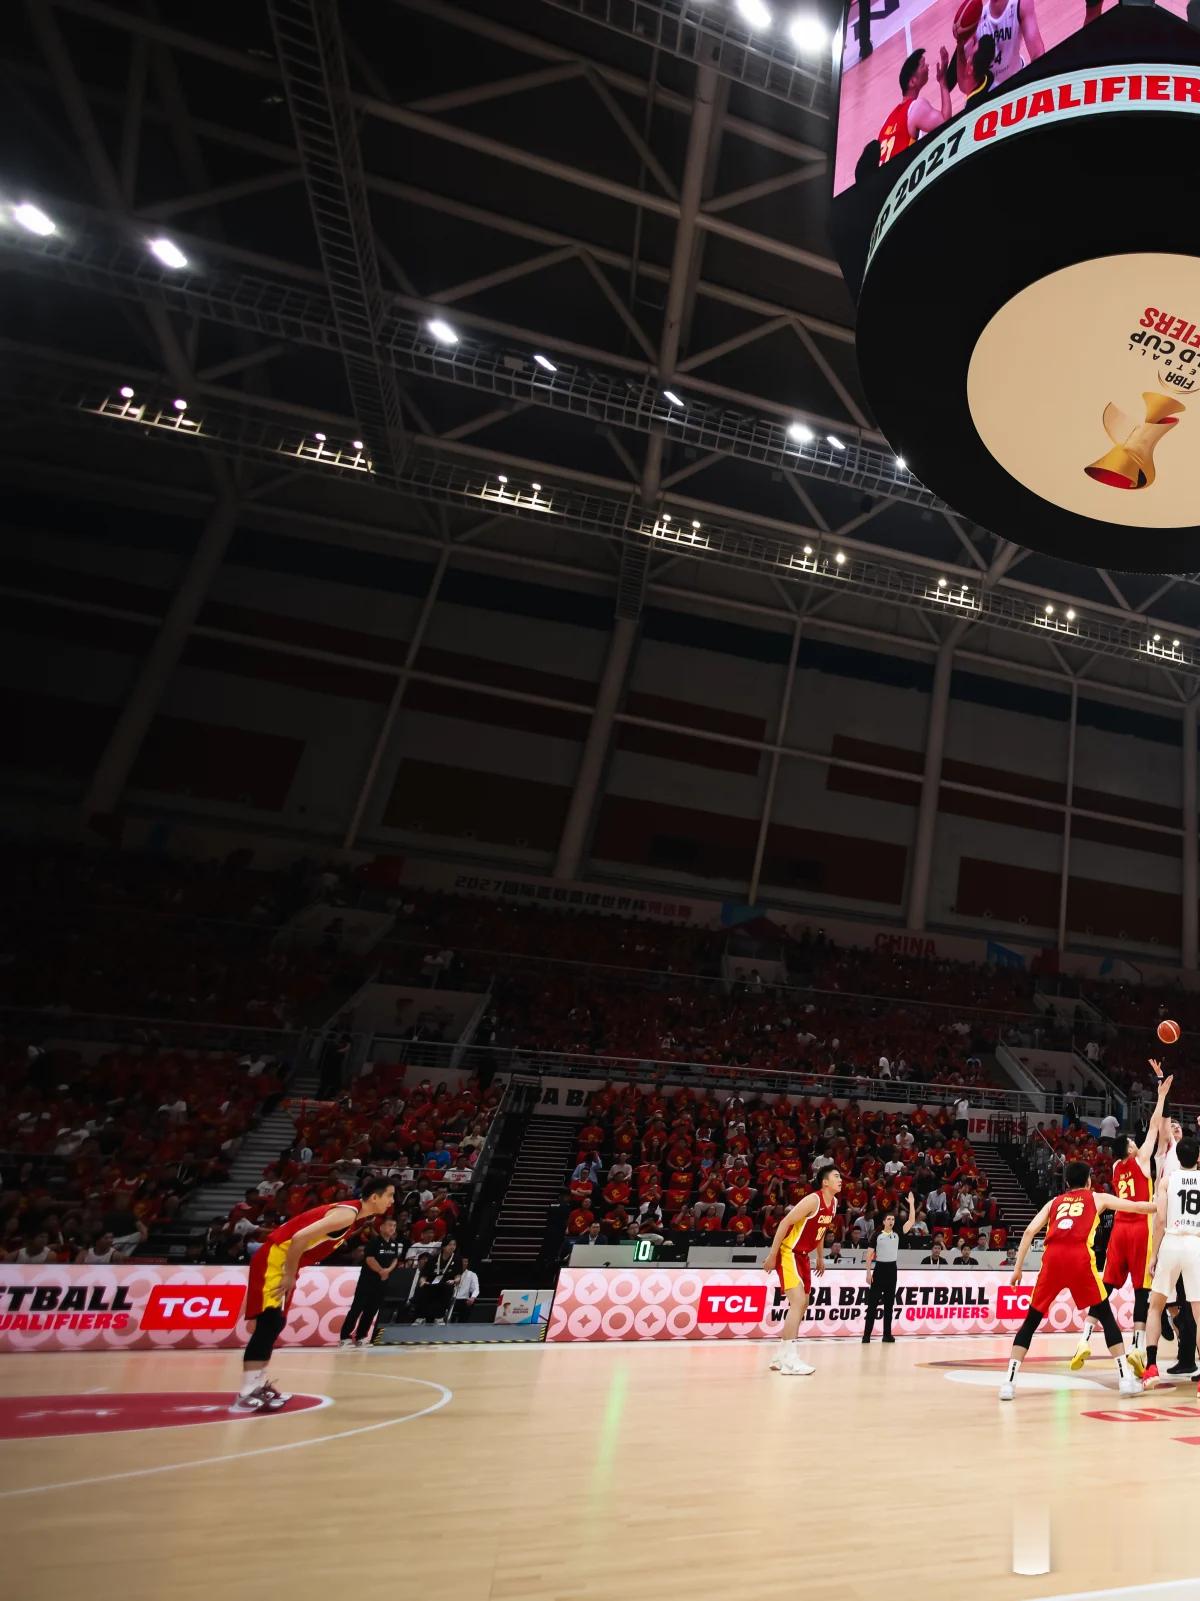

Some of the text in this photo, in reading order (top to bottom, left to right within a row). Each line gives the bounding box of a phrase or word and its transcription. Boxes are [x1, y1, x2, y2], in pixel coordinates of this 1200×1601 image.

[993, 26, 1012, 42] PAN
[894, 126, 966, 213] 2027
[1130, 330, 1176, 354] CUP
[1164, 370, 1195, 390] FIBA
[1118, 1178, 1135, 1199] 21
[1056, 1202, 1084, 1220] 26
[707, 1296, 758, 1313] TCL
[773, 1287, 989, 1306] FBA BAKETBALL
[1003, 1295, 1032, 1311] TC
[159, 1297, 230, 1318] TCL
[771, 1308, 826, 1321] WLD
[829, 1308, 861, 1320] CUP
[906, 1307, 989, 1321] QUALIFIERS
